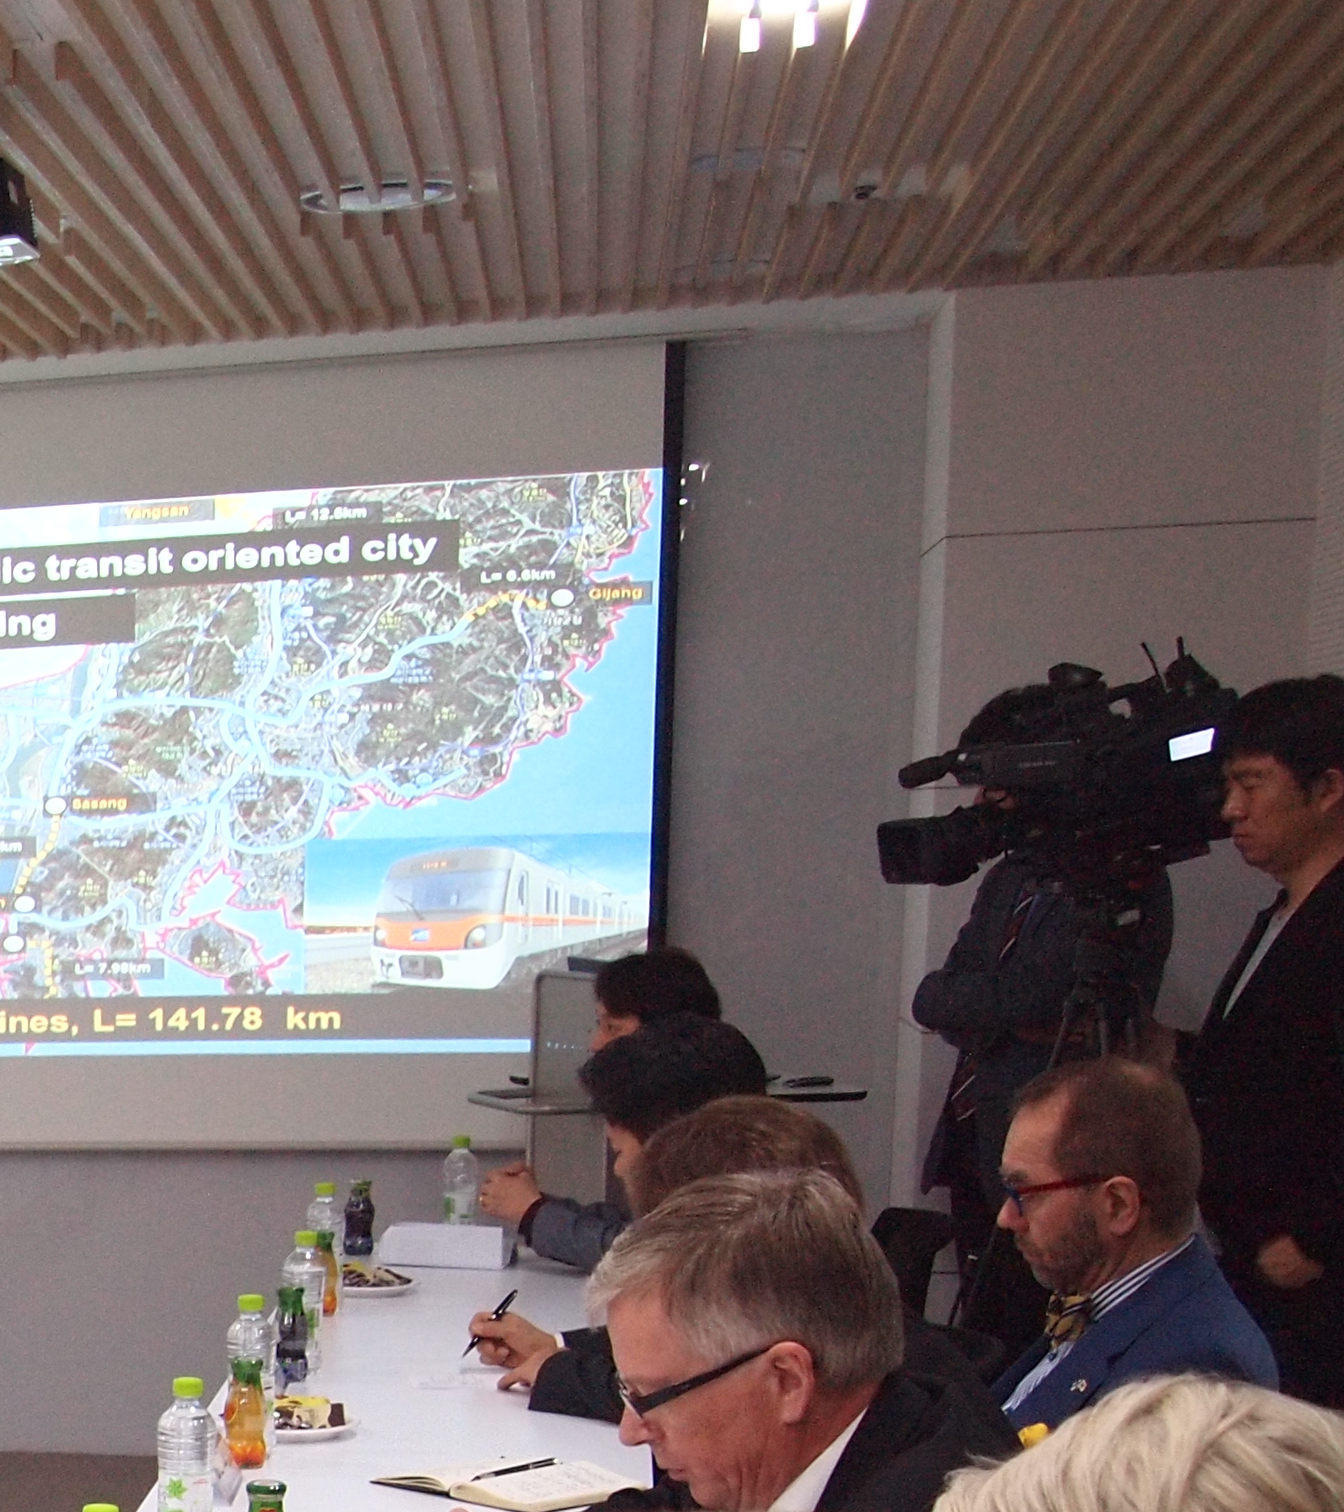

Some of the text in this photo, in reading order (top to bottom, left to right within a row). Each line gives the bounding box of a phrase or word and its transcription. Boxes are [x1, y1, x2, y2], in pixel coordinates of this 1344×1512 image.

[45, 546, 174, 581] transit
[181, 535, 350, 574] oriented
[360, 532, 437, 566] city
[588, 586, 644, 602] Gijang
[93, 1008, 137, 1033] L=
[148, 1006, 263, 1032] 141.78
[286, 1006, 342, 1031] km
